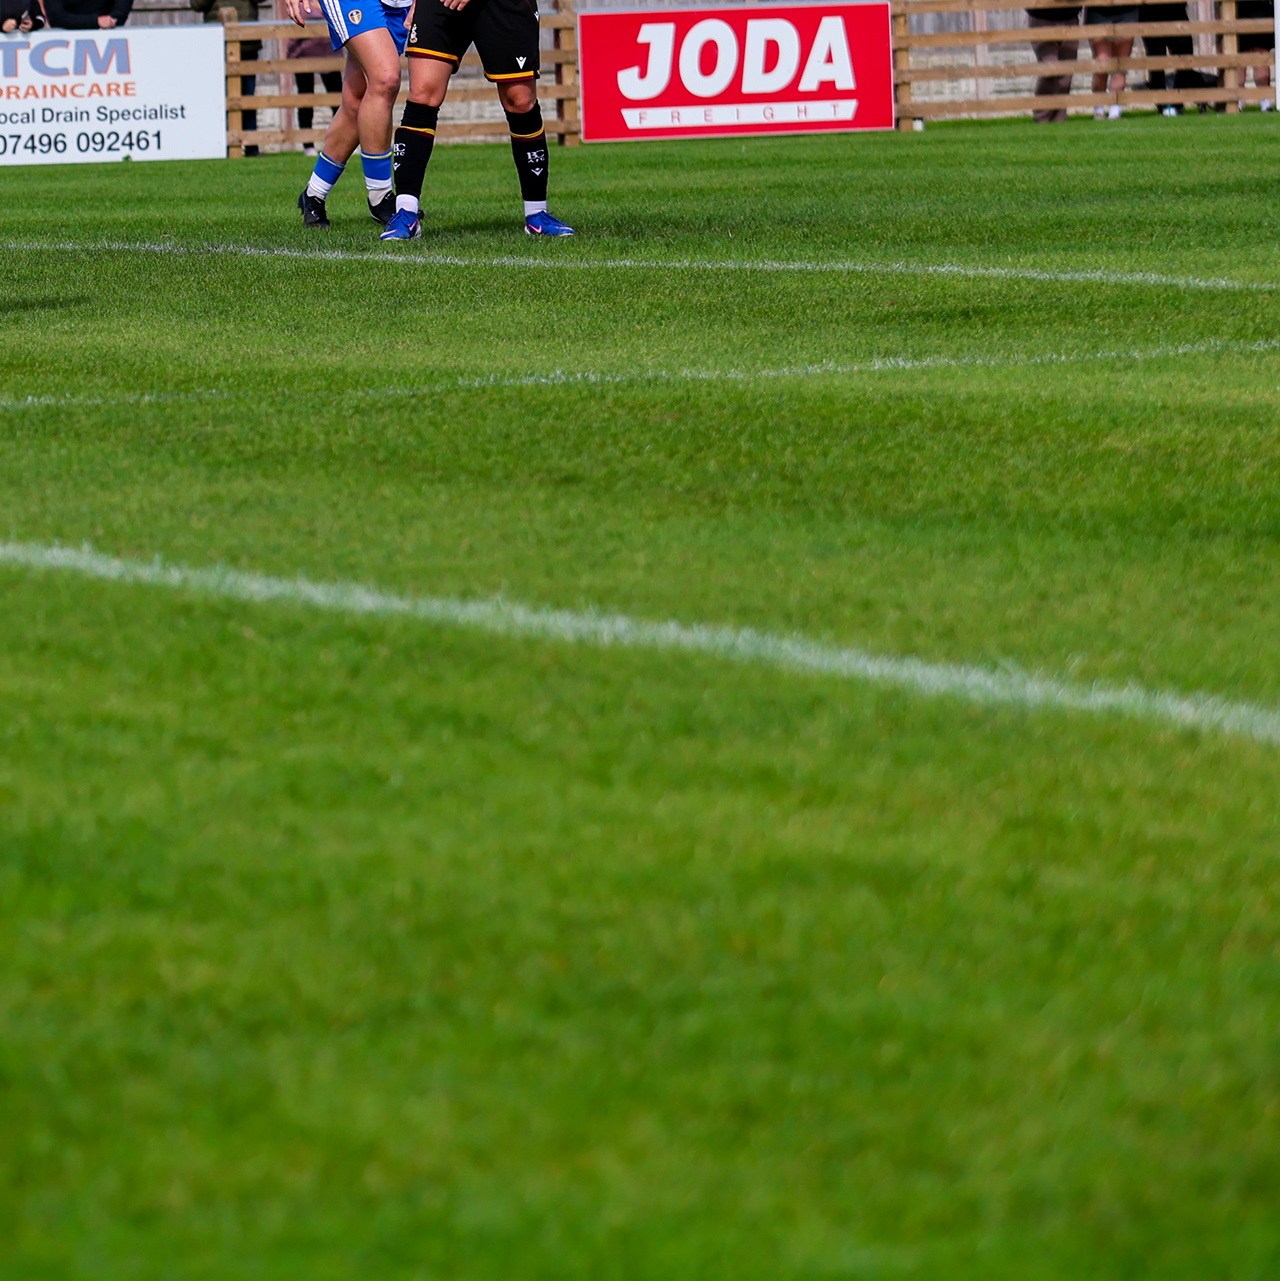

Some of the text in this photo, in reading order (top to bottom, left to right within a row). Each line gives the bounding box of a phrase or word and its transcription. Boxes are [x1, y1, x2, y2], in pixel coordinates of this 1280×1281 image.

[617, 15, 856, 100] JODA
[42, 106, 90, 122] Drain
[96, 104, 186, 124] Specialist
[639, 103, 842, 124] FREIGHT
[76, 129, 162, 153] 092461
